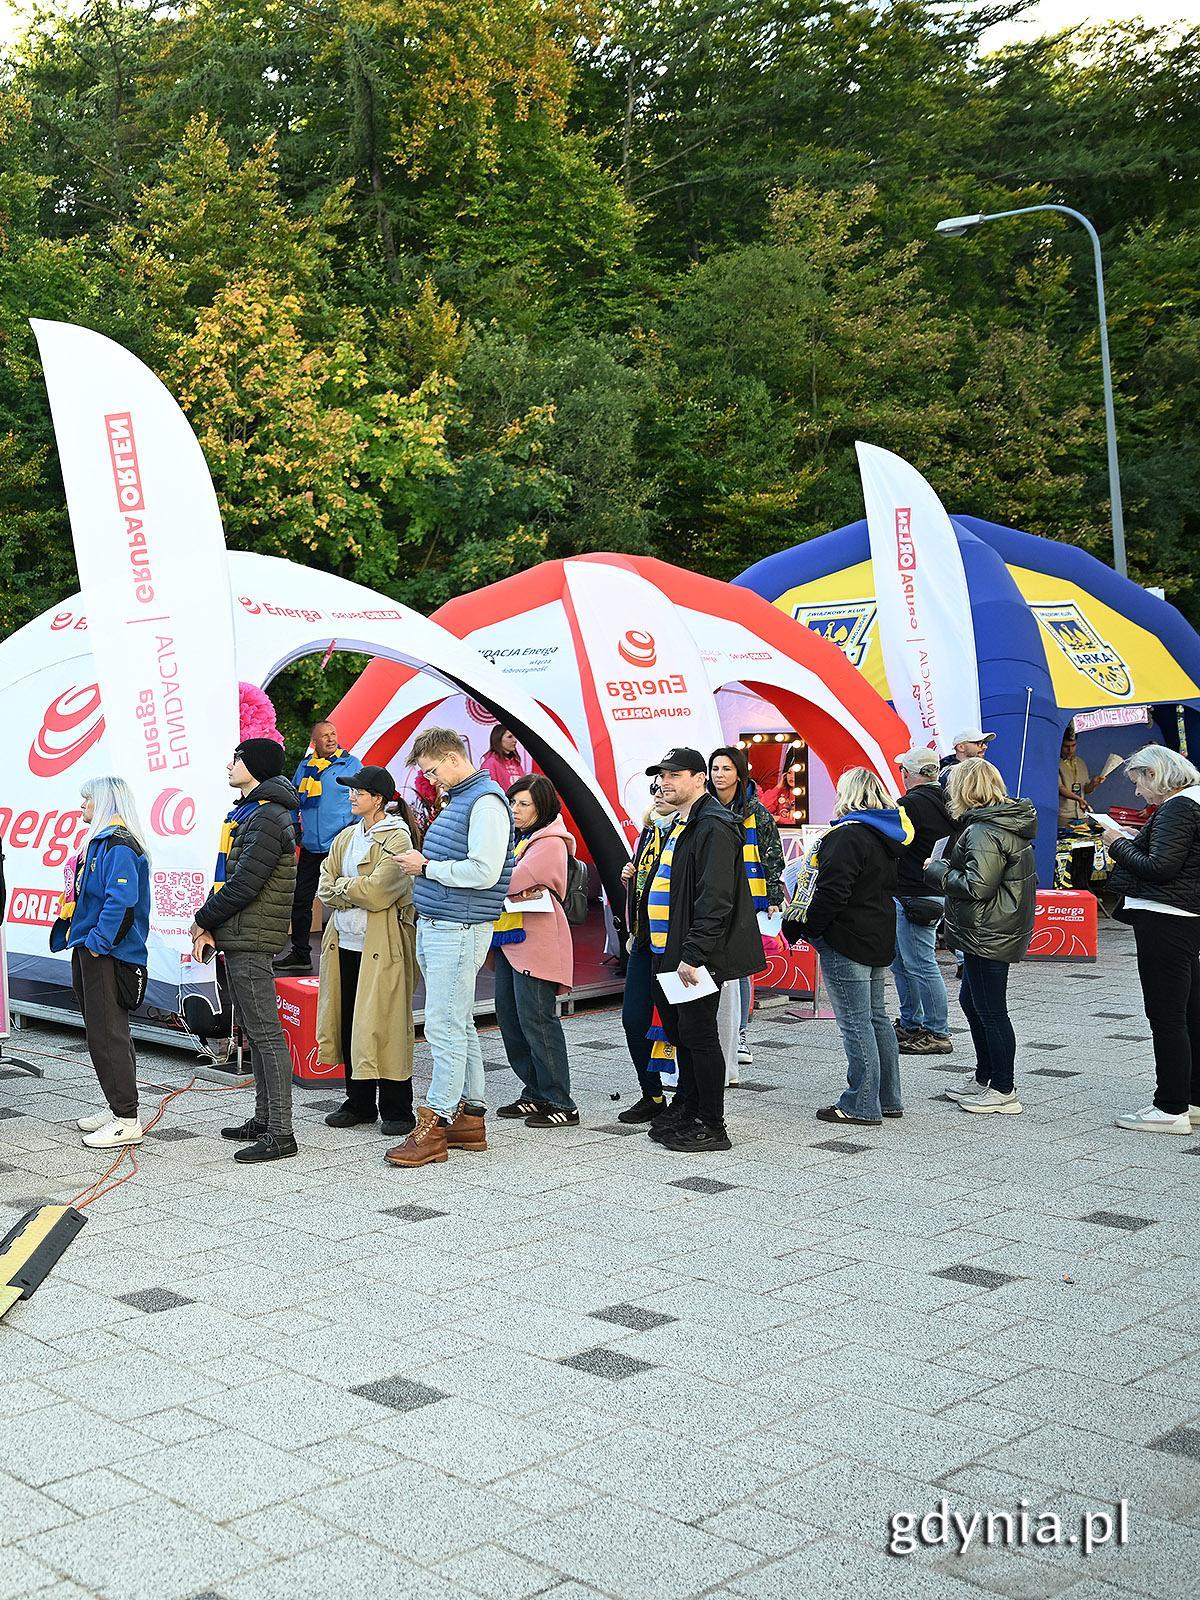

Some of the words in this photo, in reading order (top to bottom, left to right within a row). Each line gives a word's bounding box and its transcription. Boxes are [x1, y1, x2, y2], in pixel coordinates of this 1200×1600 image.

[263, 602, 322, 623] Energa
[522, 646, 559, 657] Energa
[1079, 652, 1114, 665] ARKA
[12, 892, 64, 922] ORLE
[1047, 905, 1085, 916] Energa
